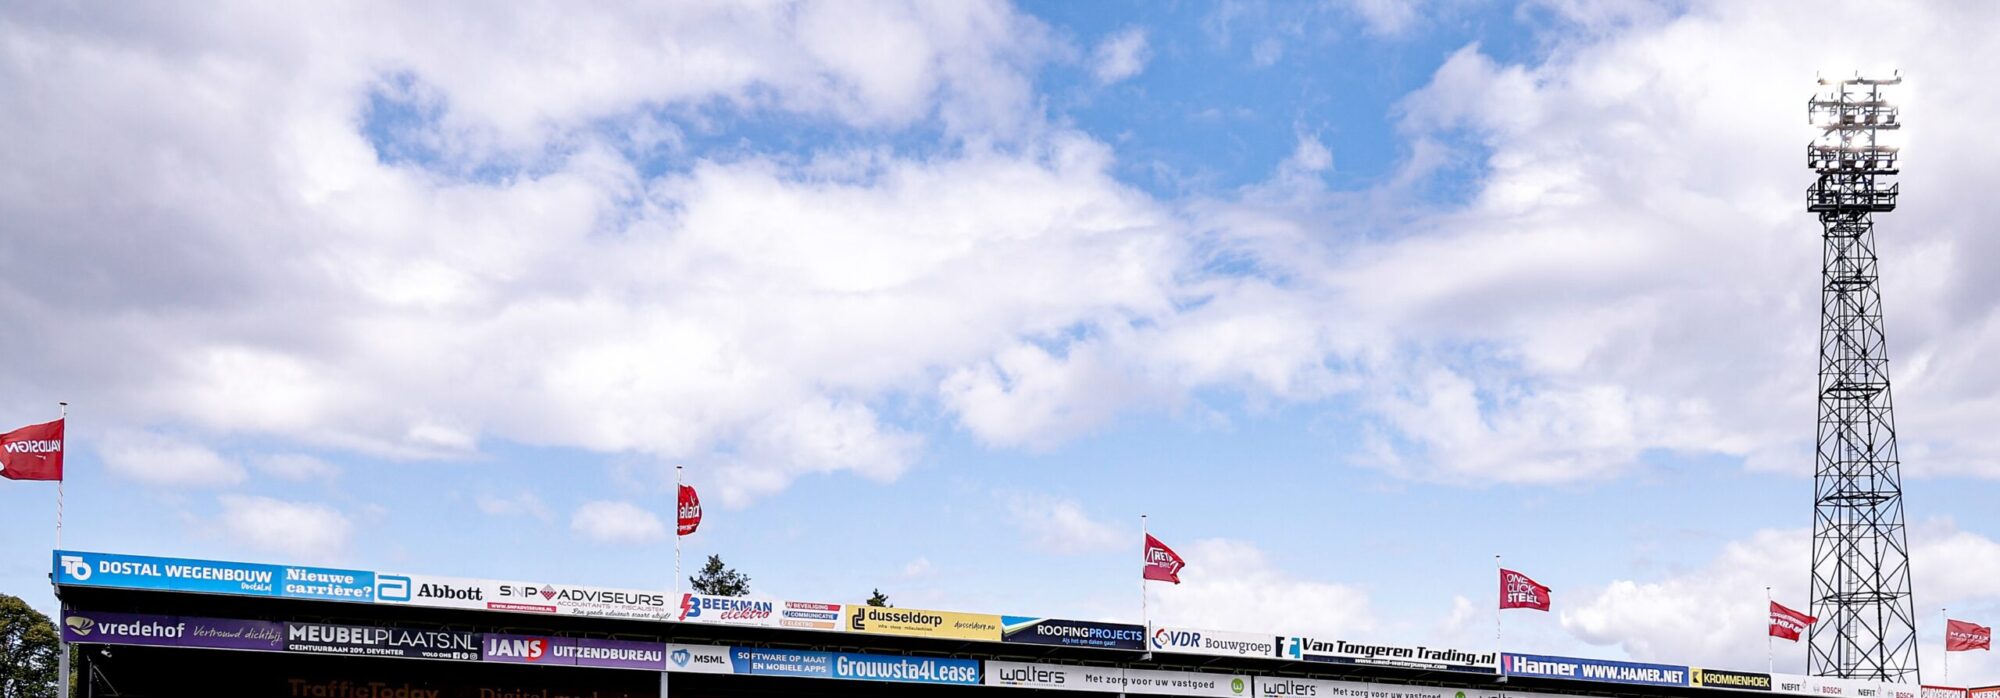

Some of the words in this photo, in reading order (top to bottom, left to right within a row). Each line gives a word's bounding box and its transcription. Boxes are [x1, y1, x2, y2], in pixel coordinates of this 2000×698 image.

[100, 560, 161, 576] DOSTAL
[165, 565, 272, 583] WEGENBOUW
[286, 568, 354, 584] Nieuwe
[1507, 574, 1527, 583] ONE
[286, 584, 372, 598] carrière?
[417, 583, 483, 600] Abbott
[500, 585, 538, 598] SNP
[557, 589, 664, 607] ADVISEURS
[1507, 584, 1535, 595] CLICK
[557, 601, 610, 609] ACCOUNTANTS
[702, 598, 772, 612] BEEKMAN
[1508, 593, 1540, 604] STEEL
[720, 606, 770, 620] elektro
[869, 609, 942, 627] dusseldorp
[98, 620, 185, 638] vredehof
[193, 625, 244, 639] Vertrouwd
[1037, 624, 1143, 641] ROOFINGPROJECTS
[1951, 632, 1989, 640] MATRIX
[289, 624, 478, 650] MEUBELPLAATS.NL
[1170, 631, 1201, 648] VDR
[1205, 638, 1272, 654] Bouwgroep
[289, 644, 348, 653] CEINTUURBAAN
[350, 646, 365, 654] 209,
[367, 648, 404, 656] DEVENTER
[488, 638, 542, 658] JANS
[553, 645, 662, 662] UITZENDBUREAU
[1302, 638, 1333, 652] Van
[1336, 641, 1413, 659] Tongeren
[1417, 647, 1496, 665] Trading.nl
[694, 655, 725, 664] MSML
[737, 652, 787, 662] SOFTWARE
[752, 662, 764, 670] EN
[766, 664, 802, 672] MOBIELE
[804, 665, 827, 673] APPS
[1000, 665, 1065, 684] wolters
[1514, 656, 1579, 676] Hamer
[1582, 664, 1683, 683] WWW.HAMER.NET
[1086, 674, 1103, 683] Met
[1107, 677, 1128, 686] zorg
[1155, 679, 1168, 687] uw
[1172, 680, 1215, 690] vastgoed
[1704, 674, 1770, 688] KROMMENHOEK
[1263, 680, 1317, 697] wolters
[1333, 687, 1347, 696] Met
[1351, 690, 1368, 698] zorg
[1782, 683, 1800, 691] NEFIT
[1822, 686, 1842, 695] BOSCH
[1858, 688, 1876, 697] NEFIT
